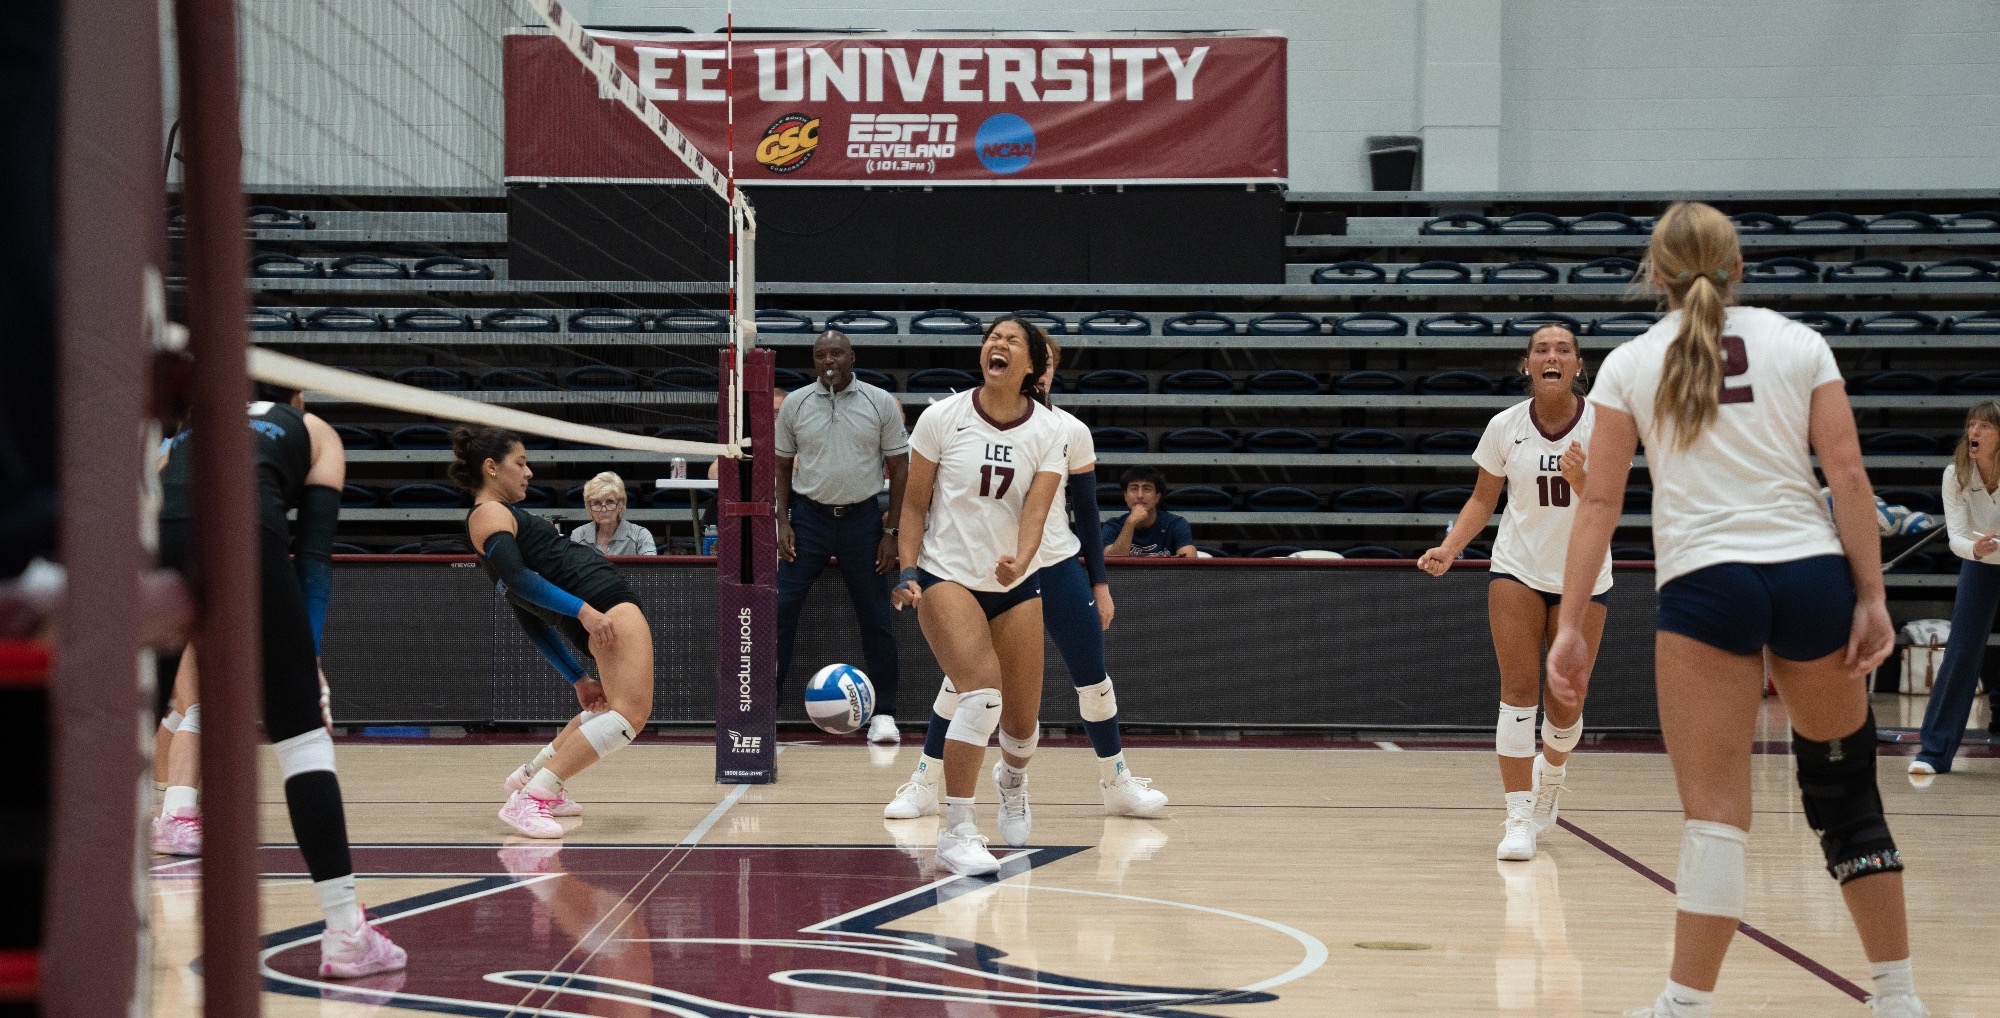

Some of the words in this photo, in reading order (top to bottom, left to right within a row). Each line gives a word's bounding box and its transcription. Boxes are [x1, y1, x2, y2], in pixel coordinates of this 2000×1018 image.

[755, 45, 1210, 103] UNIVERSITY
[755, 118, 820, 166] GSC
[847, 113, 959, 142] ESPN
[846, 144, 955, 158] CLEVELAND
[981, 142, 1036, 159] NCAA
[1716, 335, 1754, 405] 2
[984, 443, 1013, 463] LEE
[978, 464, 1015, 499] 17
[1536, 475, 1570, 508] 10
[738, 607, 752, 653] sports
[738, 655, 752, 712] imports
[845, 683, 861, 721] molten
[733, 736, 762, 748] LEE
